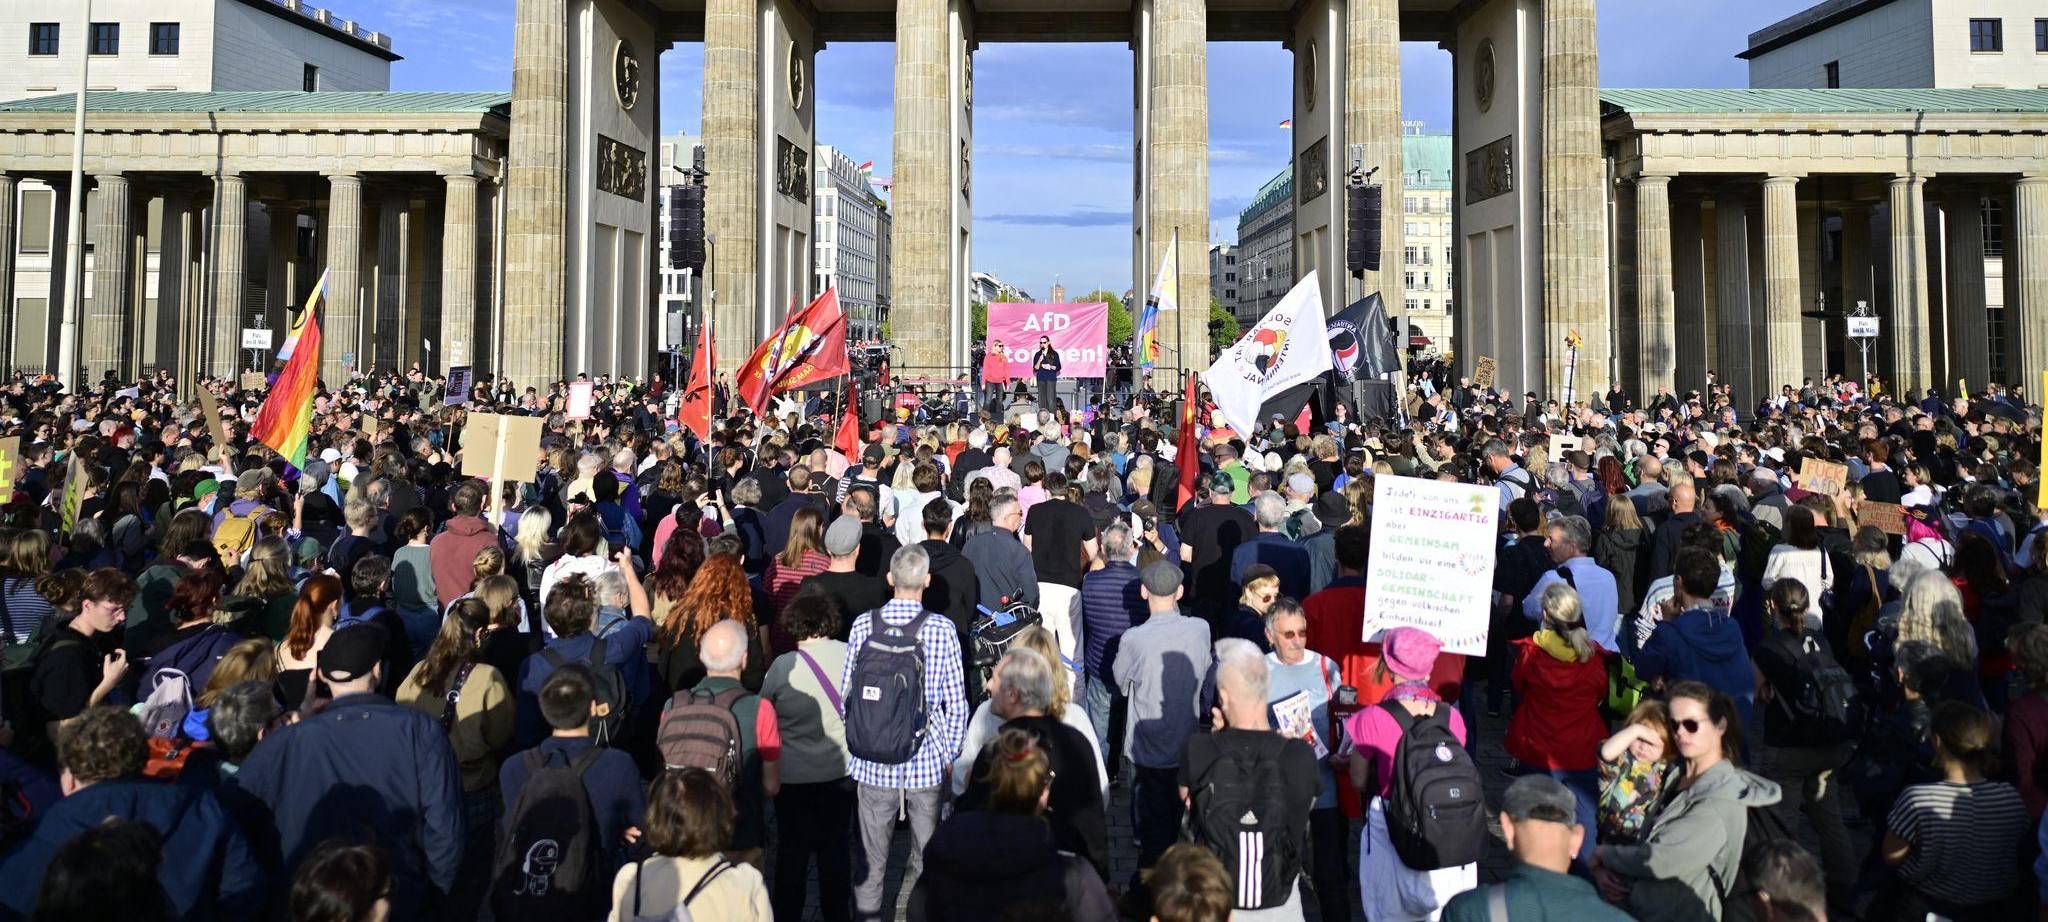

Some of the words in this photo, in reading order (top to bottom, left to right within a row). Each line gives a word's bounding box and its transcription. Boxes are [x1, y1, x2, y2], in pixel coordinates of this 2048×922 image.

[1023, 311, 1071, 332] AfD
[1806, 462, 1844, 481] FUCK
[1386, 520, 1407, 530] aber
[1409, 506, 1489, 525] EINZIGARTIG
[1388, 534, 1460, 551] GEMEINSAM
[1382, 550, 1413, 563] bilden
[1437, 560, 1457, 569] eine
[1376, 567, 1436, 581] SOLIDAR-
[1381, 584, 1475, 603] GEMEINSCHAFT
[1378, 597, 1408, 610] gegen
